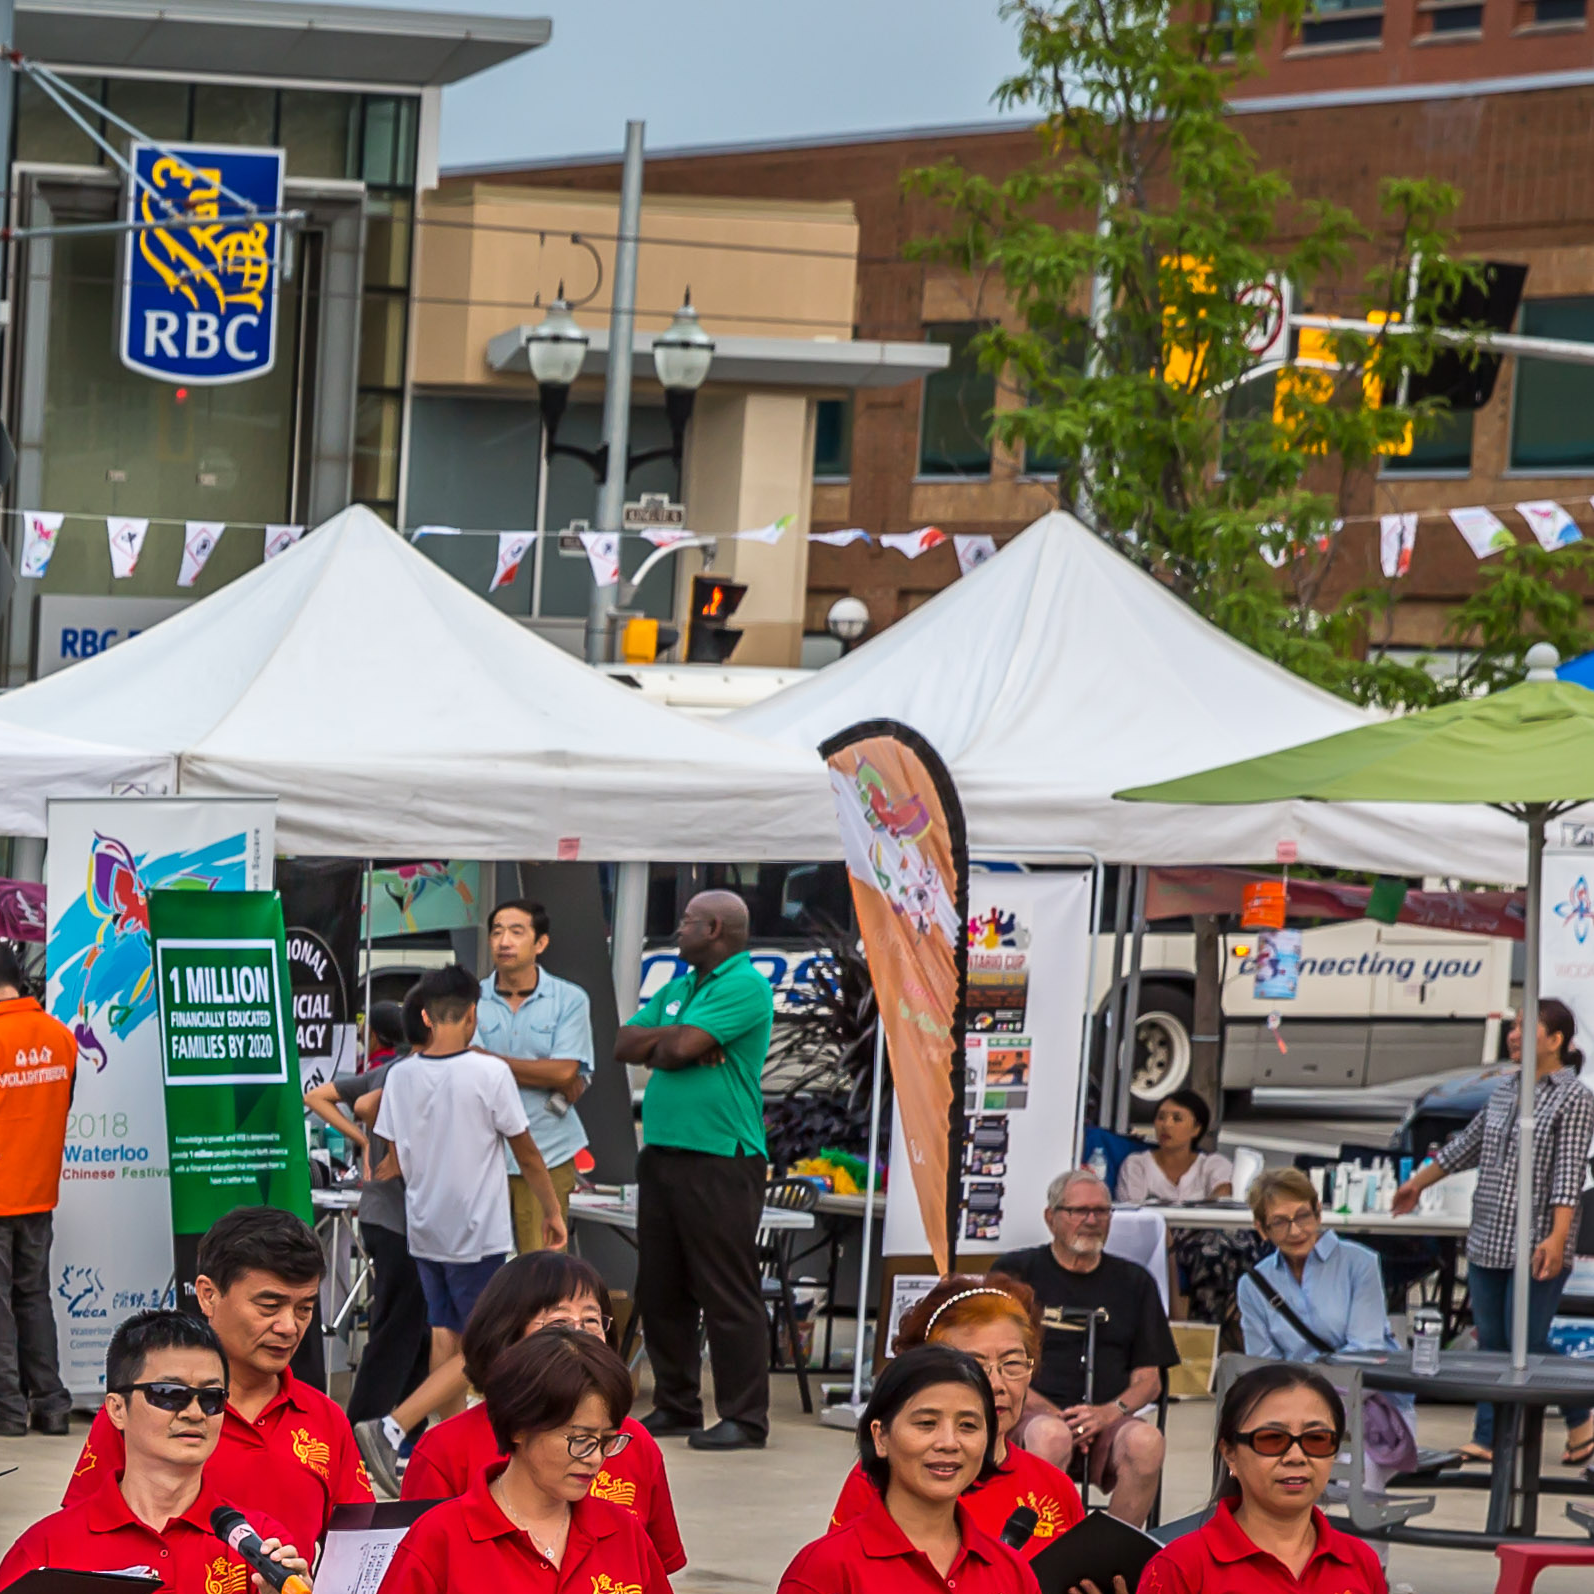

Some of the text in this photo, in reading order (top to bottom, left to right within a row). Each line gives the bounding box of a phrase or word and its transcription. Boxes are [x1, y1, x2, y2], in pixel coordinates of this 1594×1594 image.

[144, 309, 259, 362] RBC
[60, 627, 118, 659] RBC
[1422, 957, 1484, 981] you
[169, 966, 270, 1004] 1 MILLION
[170, 1010, 271, 1028] FINANCIALLY EDUCATED
[172, 1033, 274, 1059] FAMILIES BY 2020
[65, 1112, 129, 1139] 2018
[63, 1145, 149, 1163] Waterloo
[62, 1167, 116, 1180] Chinese
